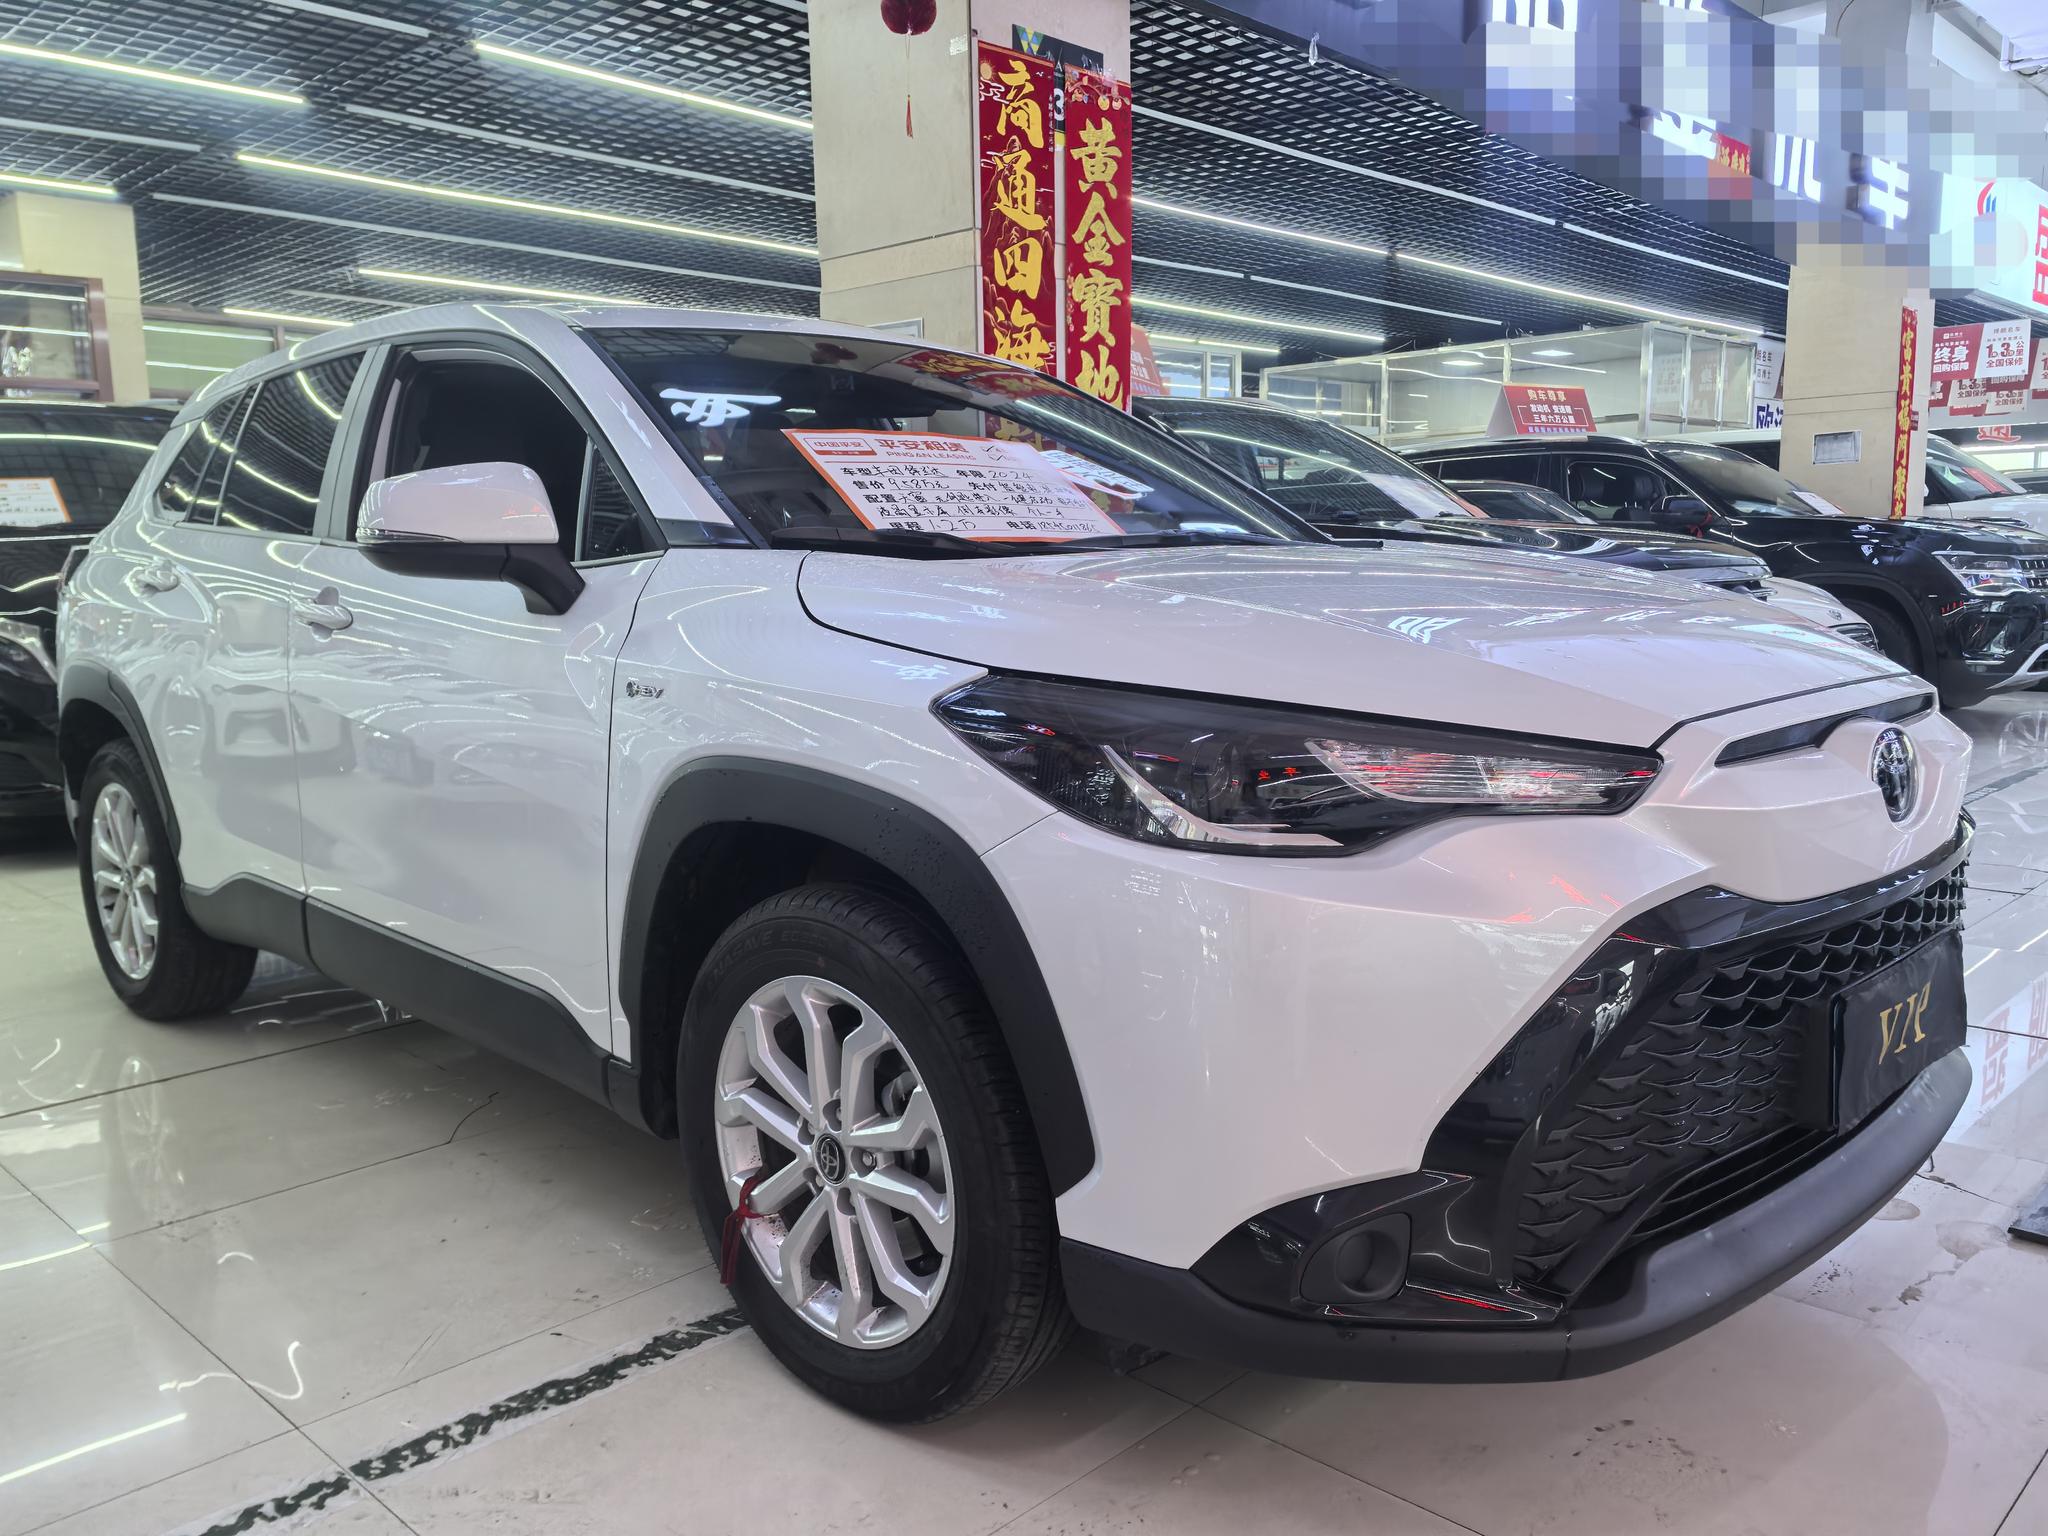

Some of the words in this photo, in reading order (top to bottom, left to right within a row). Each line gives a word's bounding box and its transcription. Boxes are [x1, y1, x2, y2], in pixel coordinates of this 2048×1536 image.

[992, 59, 1053, 374] 商通四海
[1934, 346, 1969, 362] 终身
[1932, 362, 1969, 373] 回购保障
[1986, 358, 2024, 368] 全国保修
[1533, 414, 1576, 424] 三年六万公里
[874, 438, 969, 453] 平安租赁
[933, 453, 977, 461] LEASING
[840, 467, 872, 476] 车型
[956, 470, 985, 479] 年限
[988, 470, 1033, 479] 2024
[853, 480, 886, 489] 售价
[863, 494, 899, 503] 配置
[1007, 520, 1037, 530] 电话
[1878, 980, 1932, 1065] VIP
